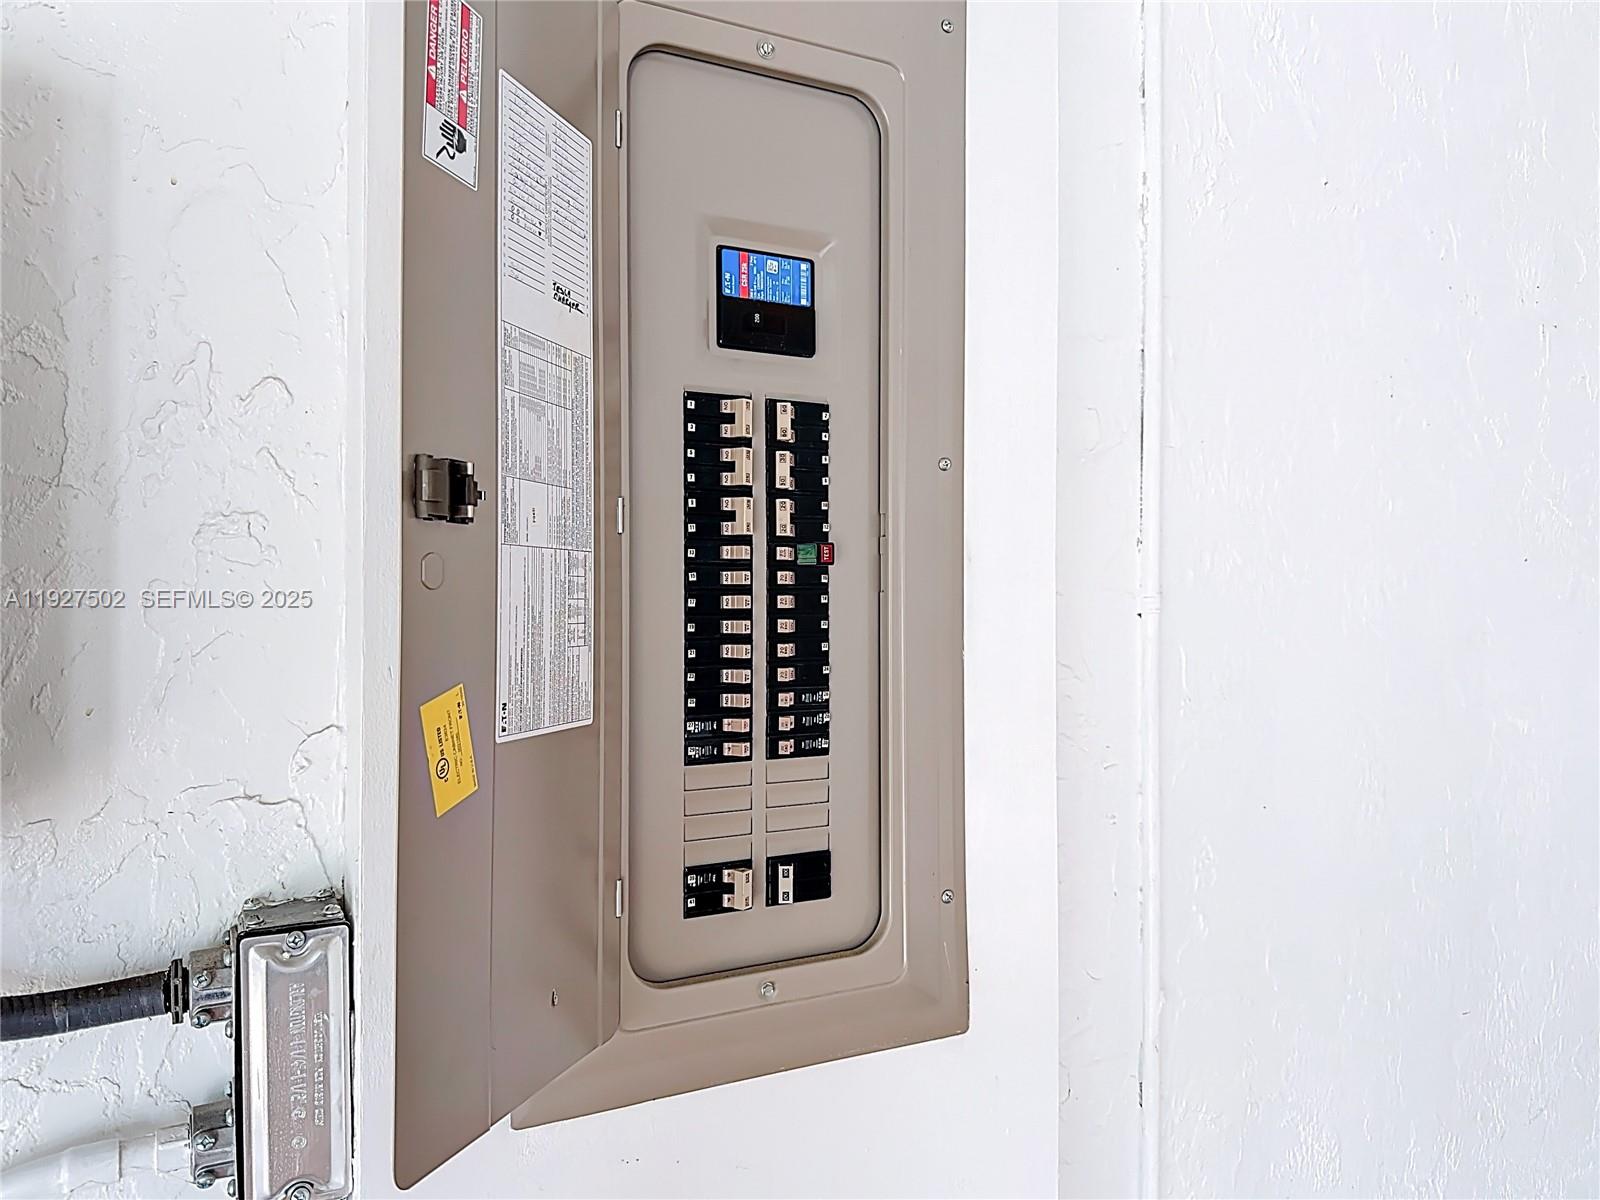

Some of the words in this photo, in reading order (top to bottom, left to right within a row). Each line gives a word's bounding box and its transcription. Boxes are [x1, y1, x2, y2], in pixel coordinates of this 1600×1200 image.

[429, 5, 438, 60] DANGER
[460, 29, 469, 85] PELIGRO
[724, 597, 730, 607] ON
[724, 622, 730, 632] ON
[724, 647, 730, 656] ON
[724, 672, 730, 681] ON
[724, 696, 729, 705] ON
[436, 727, 444, 747] LISTED
[450, 730, 458, 755] CABINET
[453, 756, 462, 784] ELECTRIC
